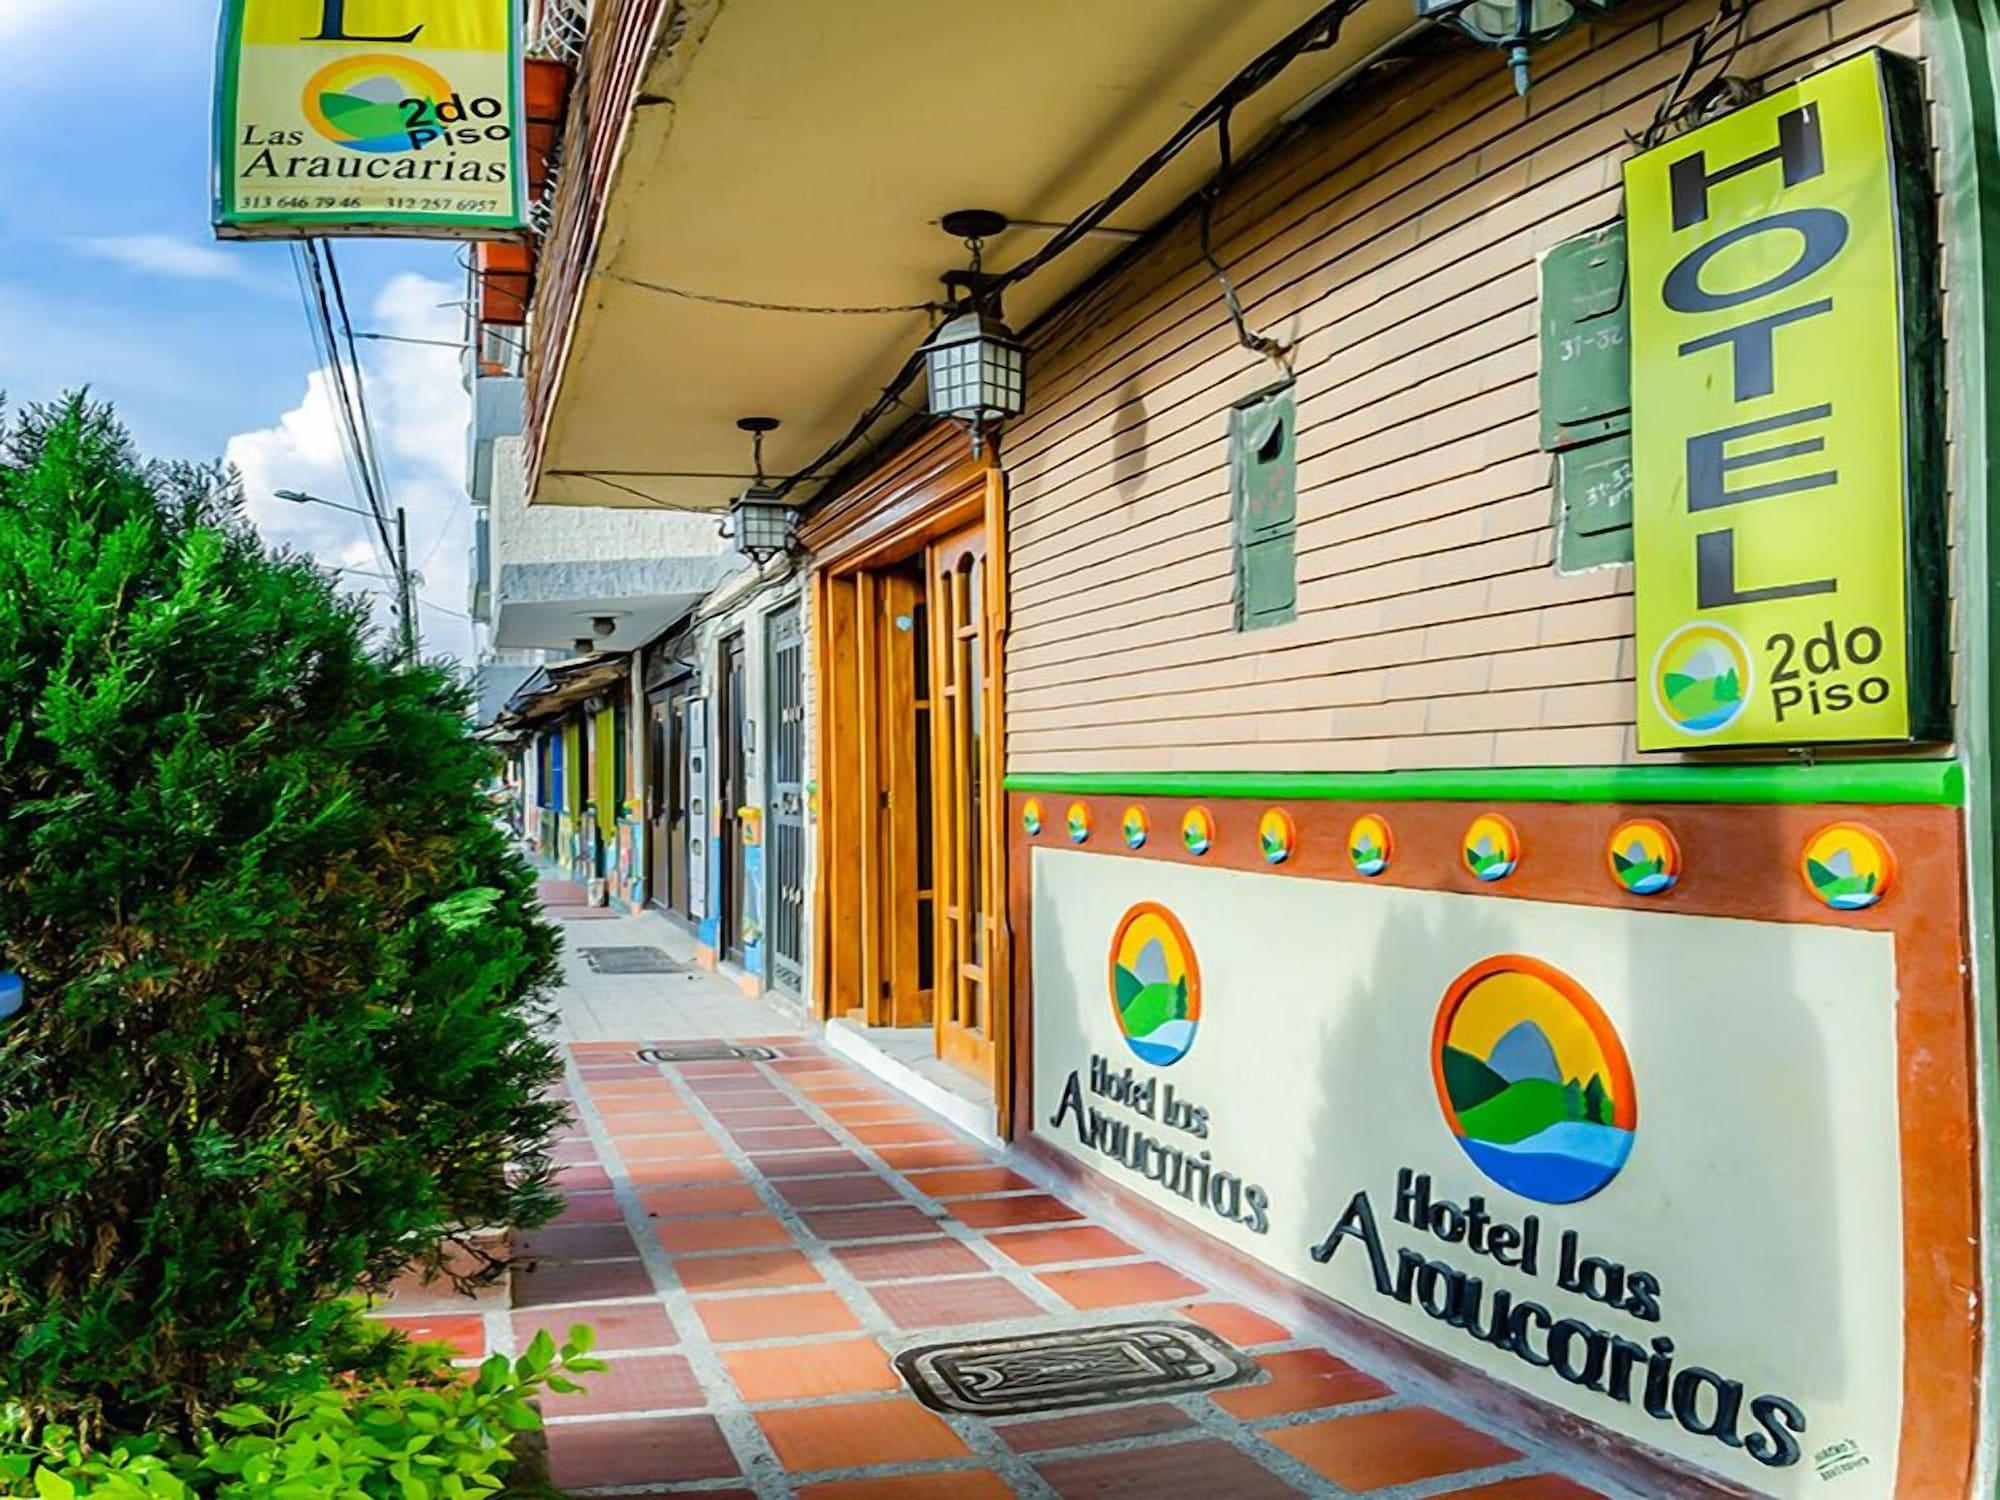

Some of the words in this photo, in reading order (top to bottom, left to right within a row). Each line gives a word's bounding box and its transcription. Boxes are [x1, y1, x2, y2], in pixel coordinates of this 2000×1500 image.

[241, 125, 304, 146] Las
[398, 93, 501, 127] 2do
[408, 124, 511, 150] Piso
[240, 149, 507, 183] Araucarias
[241, 196, 272, 209] 313
[277, 196, 309, 209] 646
[1661, 101, 1850, 610] HOTEL
[1765, 620, 1882, 685] 2do
[1771, 677, 1890, 722] Piso
[1090, 1054, 1156, 1120] Hotel
[1050, 1069, 1270, 1235] Araucarias
[1394, 1166, 1538, 1276] Hotel
[1310, 1190, 1806, 1468] Araucarias
